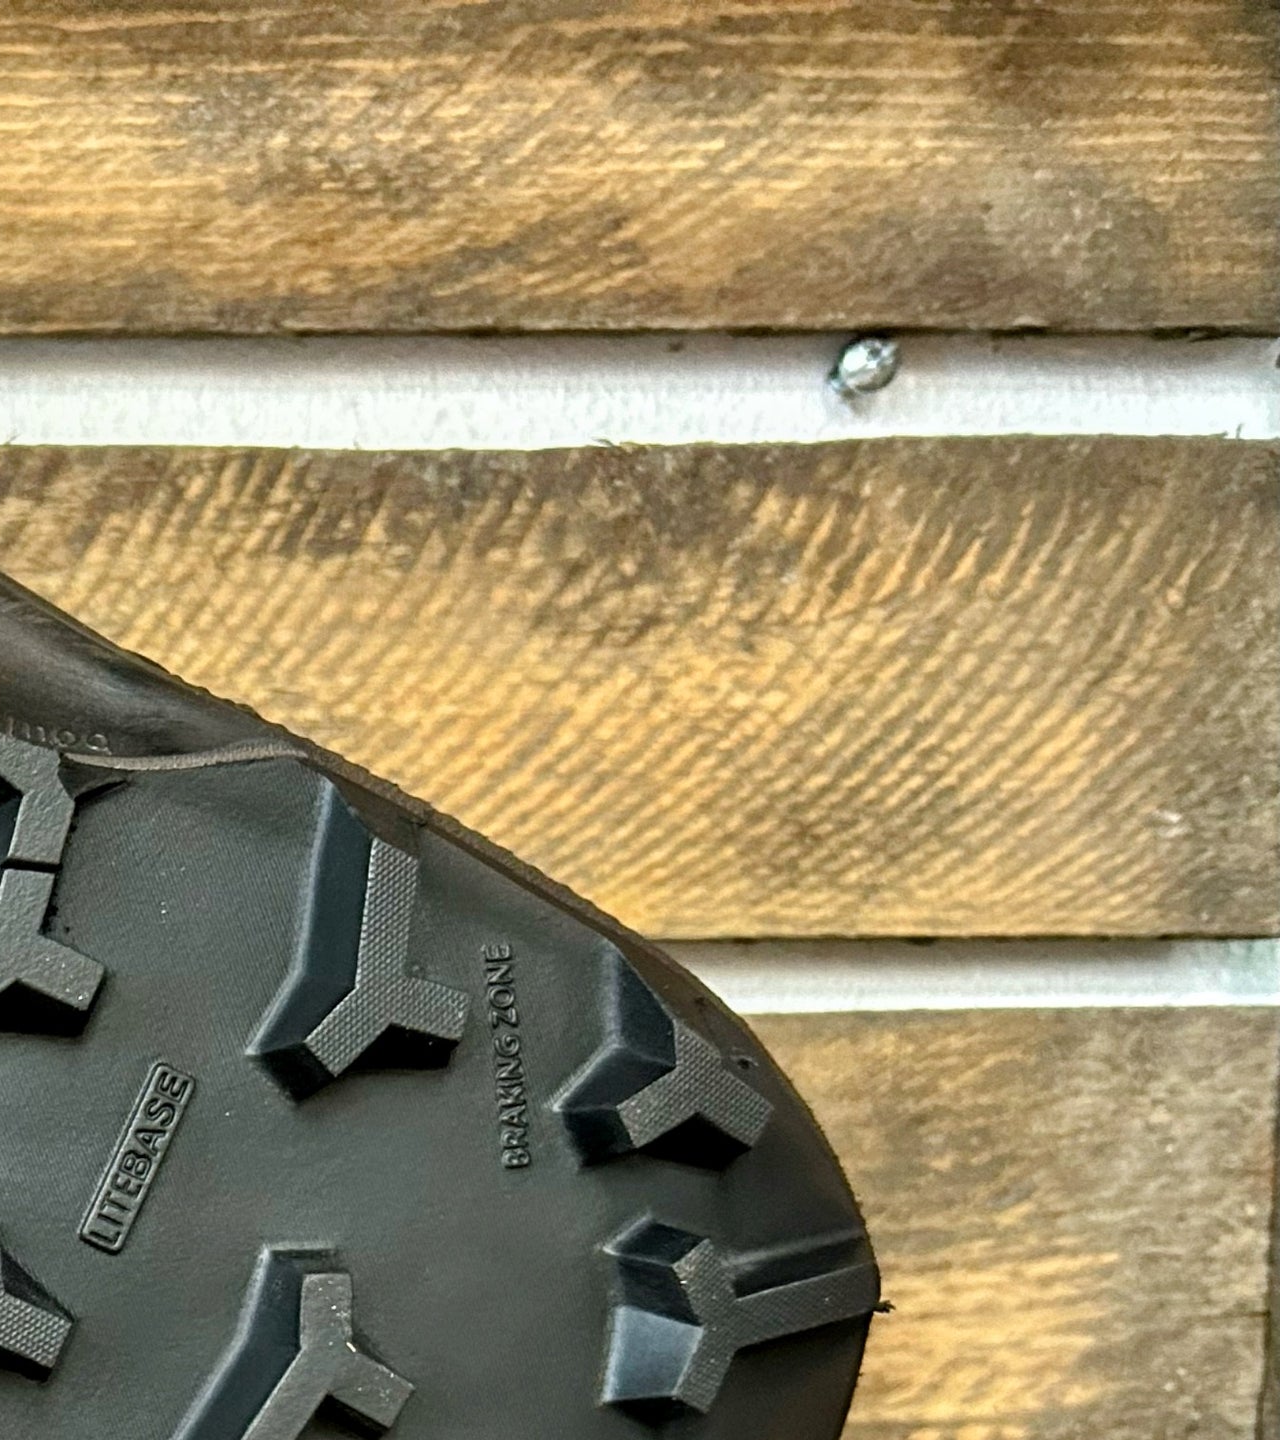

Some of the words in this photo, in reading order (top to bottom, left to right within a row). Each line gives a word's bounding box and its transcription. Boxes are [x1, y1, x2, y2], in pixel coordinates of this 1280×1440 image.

[482, 943, 521, 1029] ZONE
[88, 1070, 191, 1246] LITEBASE
[493, 1033, 532, 1170] BRAKING
